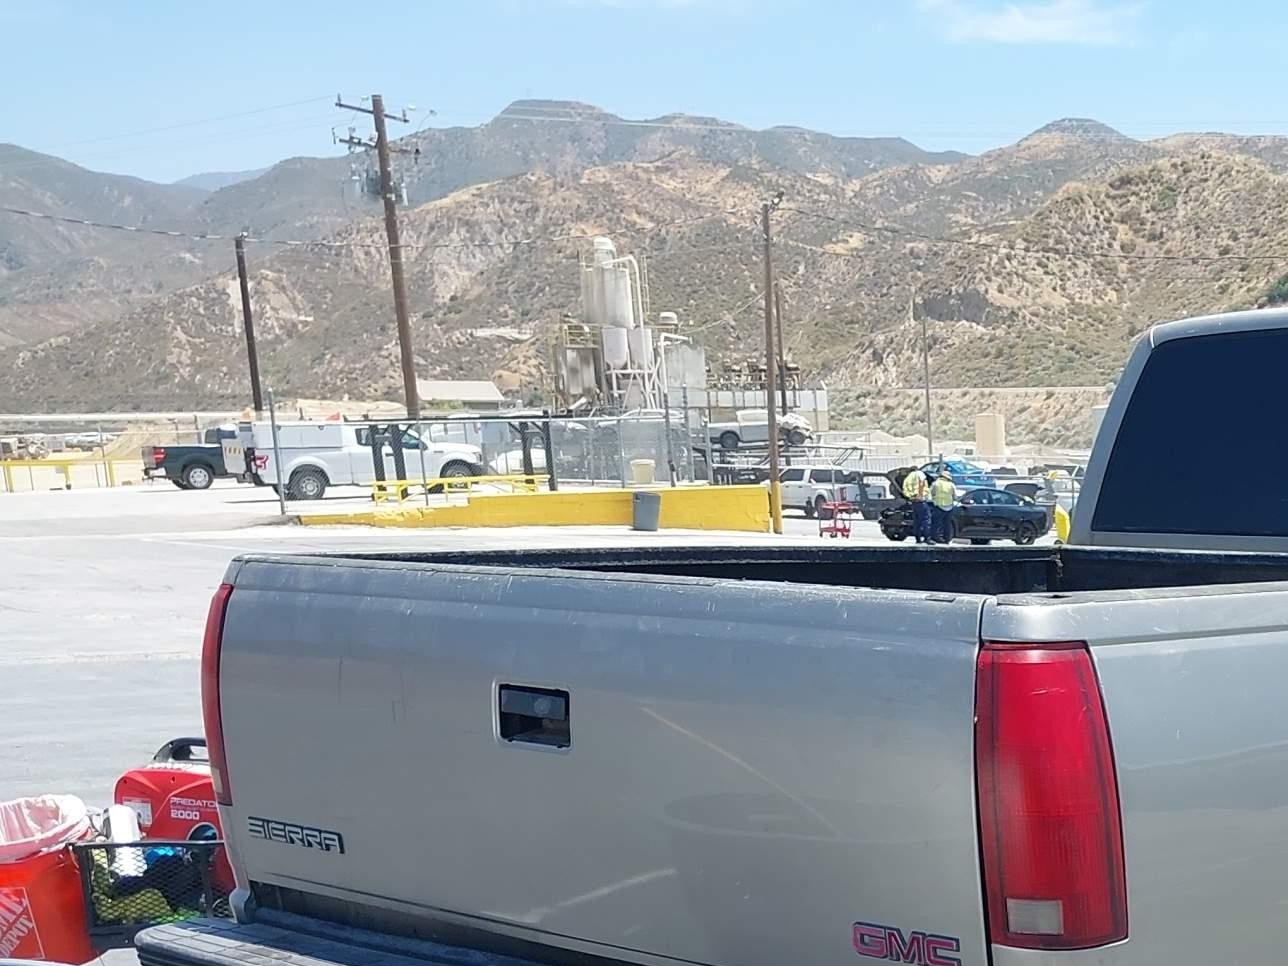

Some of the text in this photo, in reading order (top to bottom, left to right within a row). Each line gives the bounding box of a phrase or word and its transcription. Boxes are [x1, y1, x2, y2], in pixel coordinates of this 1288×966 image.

[170, 797, 217, 808] PREDATO
[170, 809, 200, 821] 2000
[247, 816, 345, 855] SIERRA
